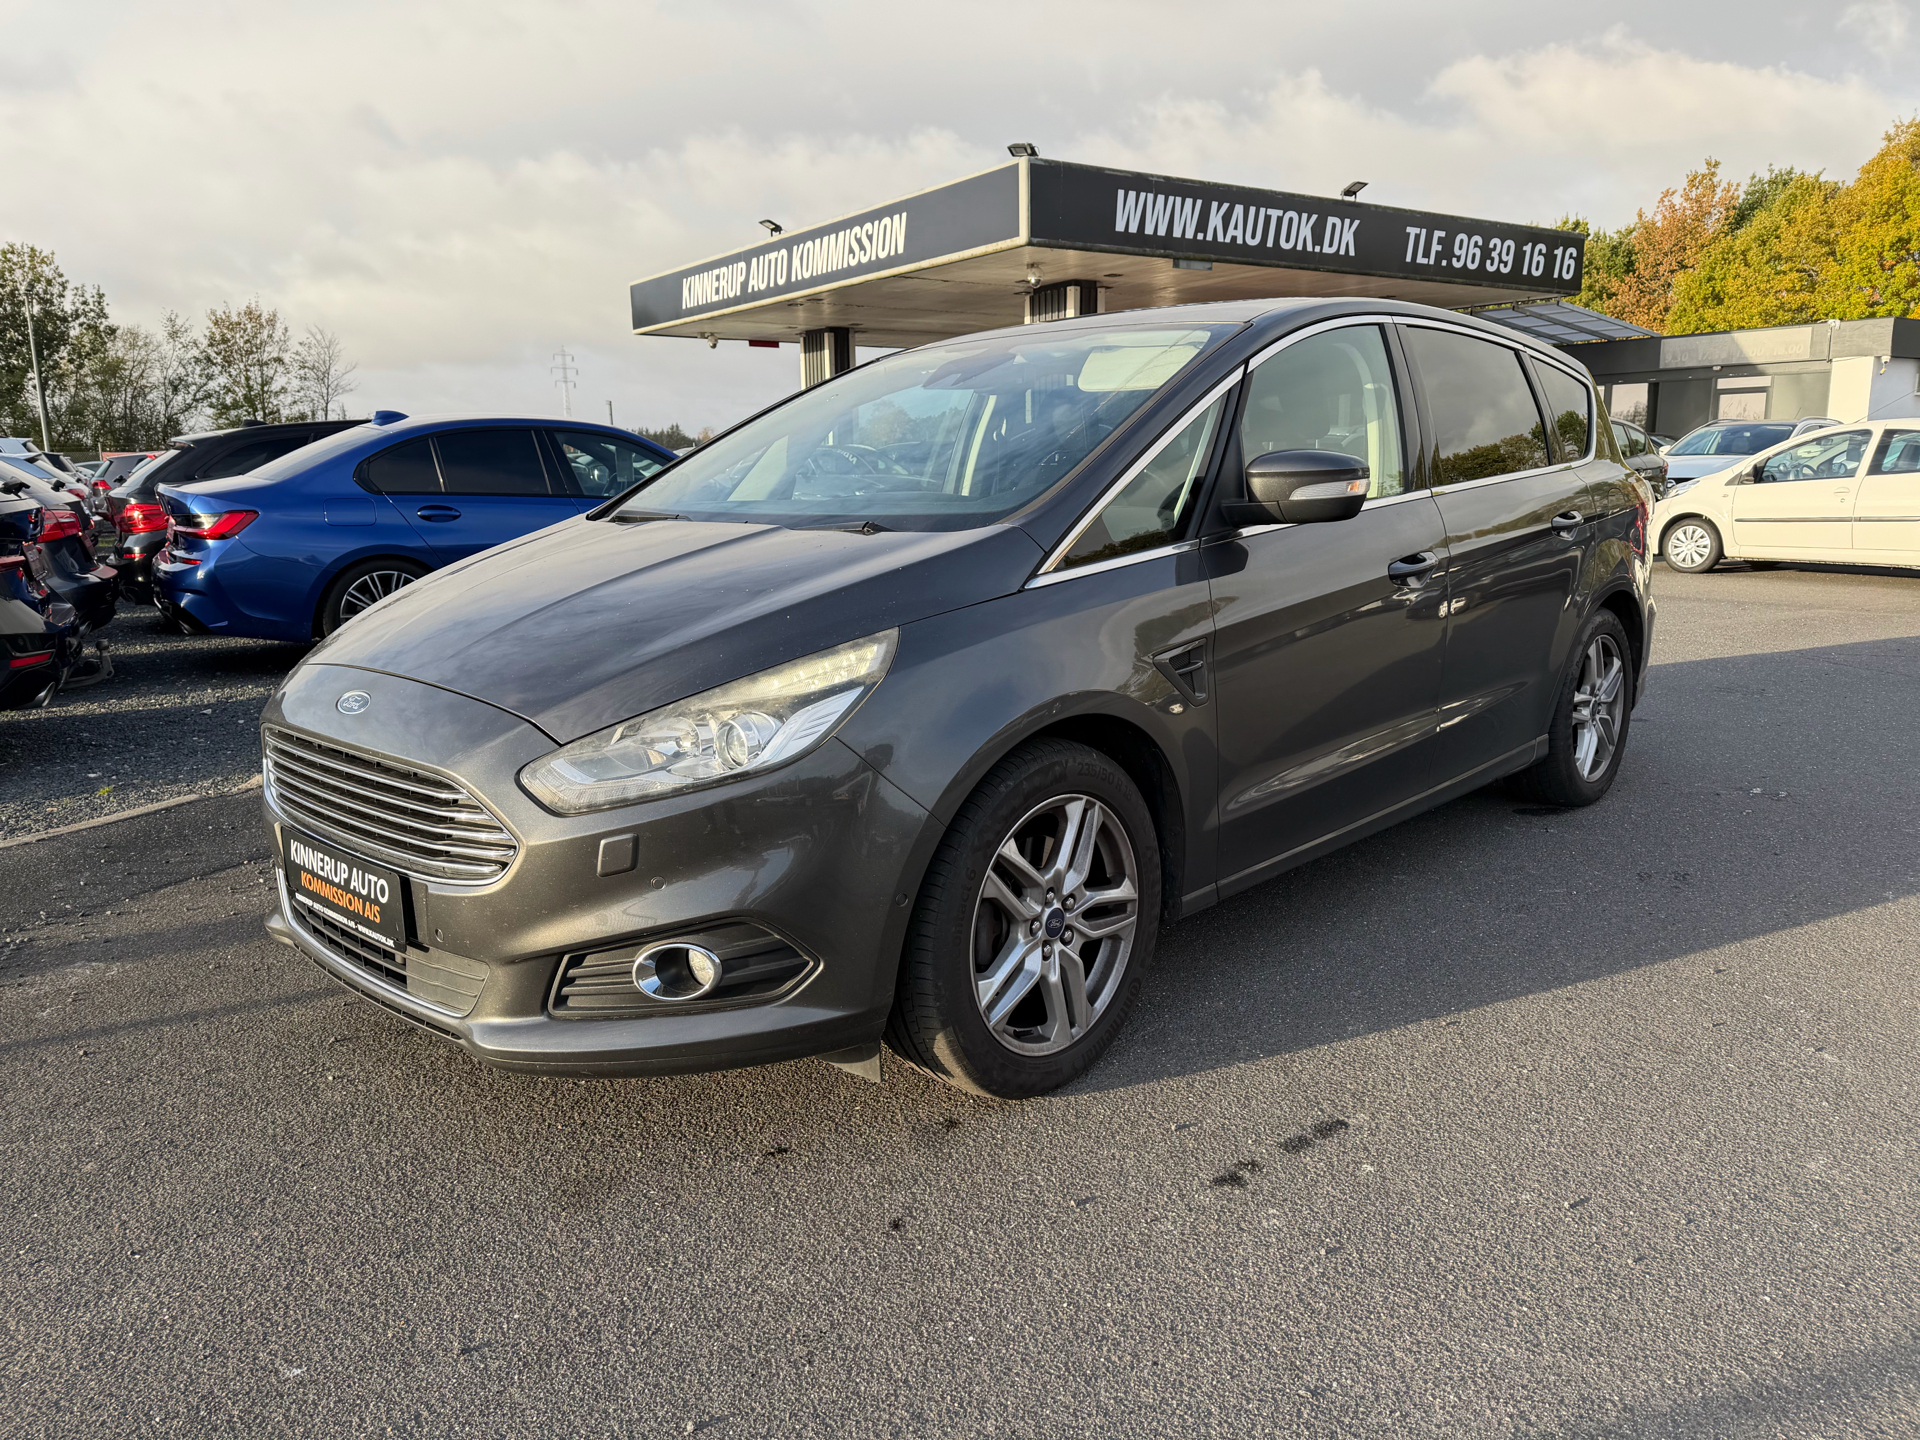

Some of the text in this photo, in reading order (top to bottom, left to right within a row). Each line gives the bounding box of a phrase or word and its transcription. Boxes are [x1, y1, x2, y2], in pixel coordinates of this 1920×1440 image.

[1114, 188, 1360, 257] WWW.KAUTOK.DK
[682, 212, 908, 310] KINNERUP AUTO KOMMISSION
[1405, 226, 1577, 281] TLF. 96 39 16 16
[1077, 762, 1114, 786] 235/50
[1115, 776, 1124, 792] R
[290, 839, 389, 904] KINNERUP AUTO
[301, 870, 363, 916] KOMMISSION
